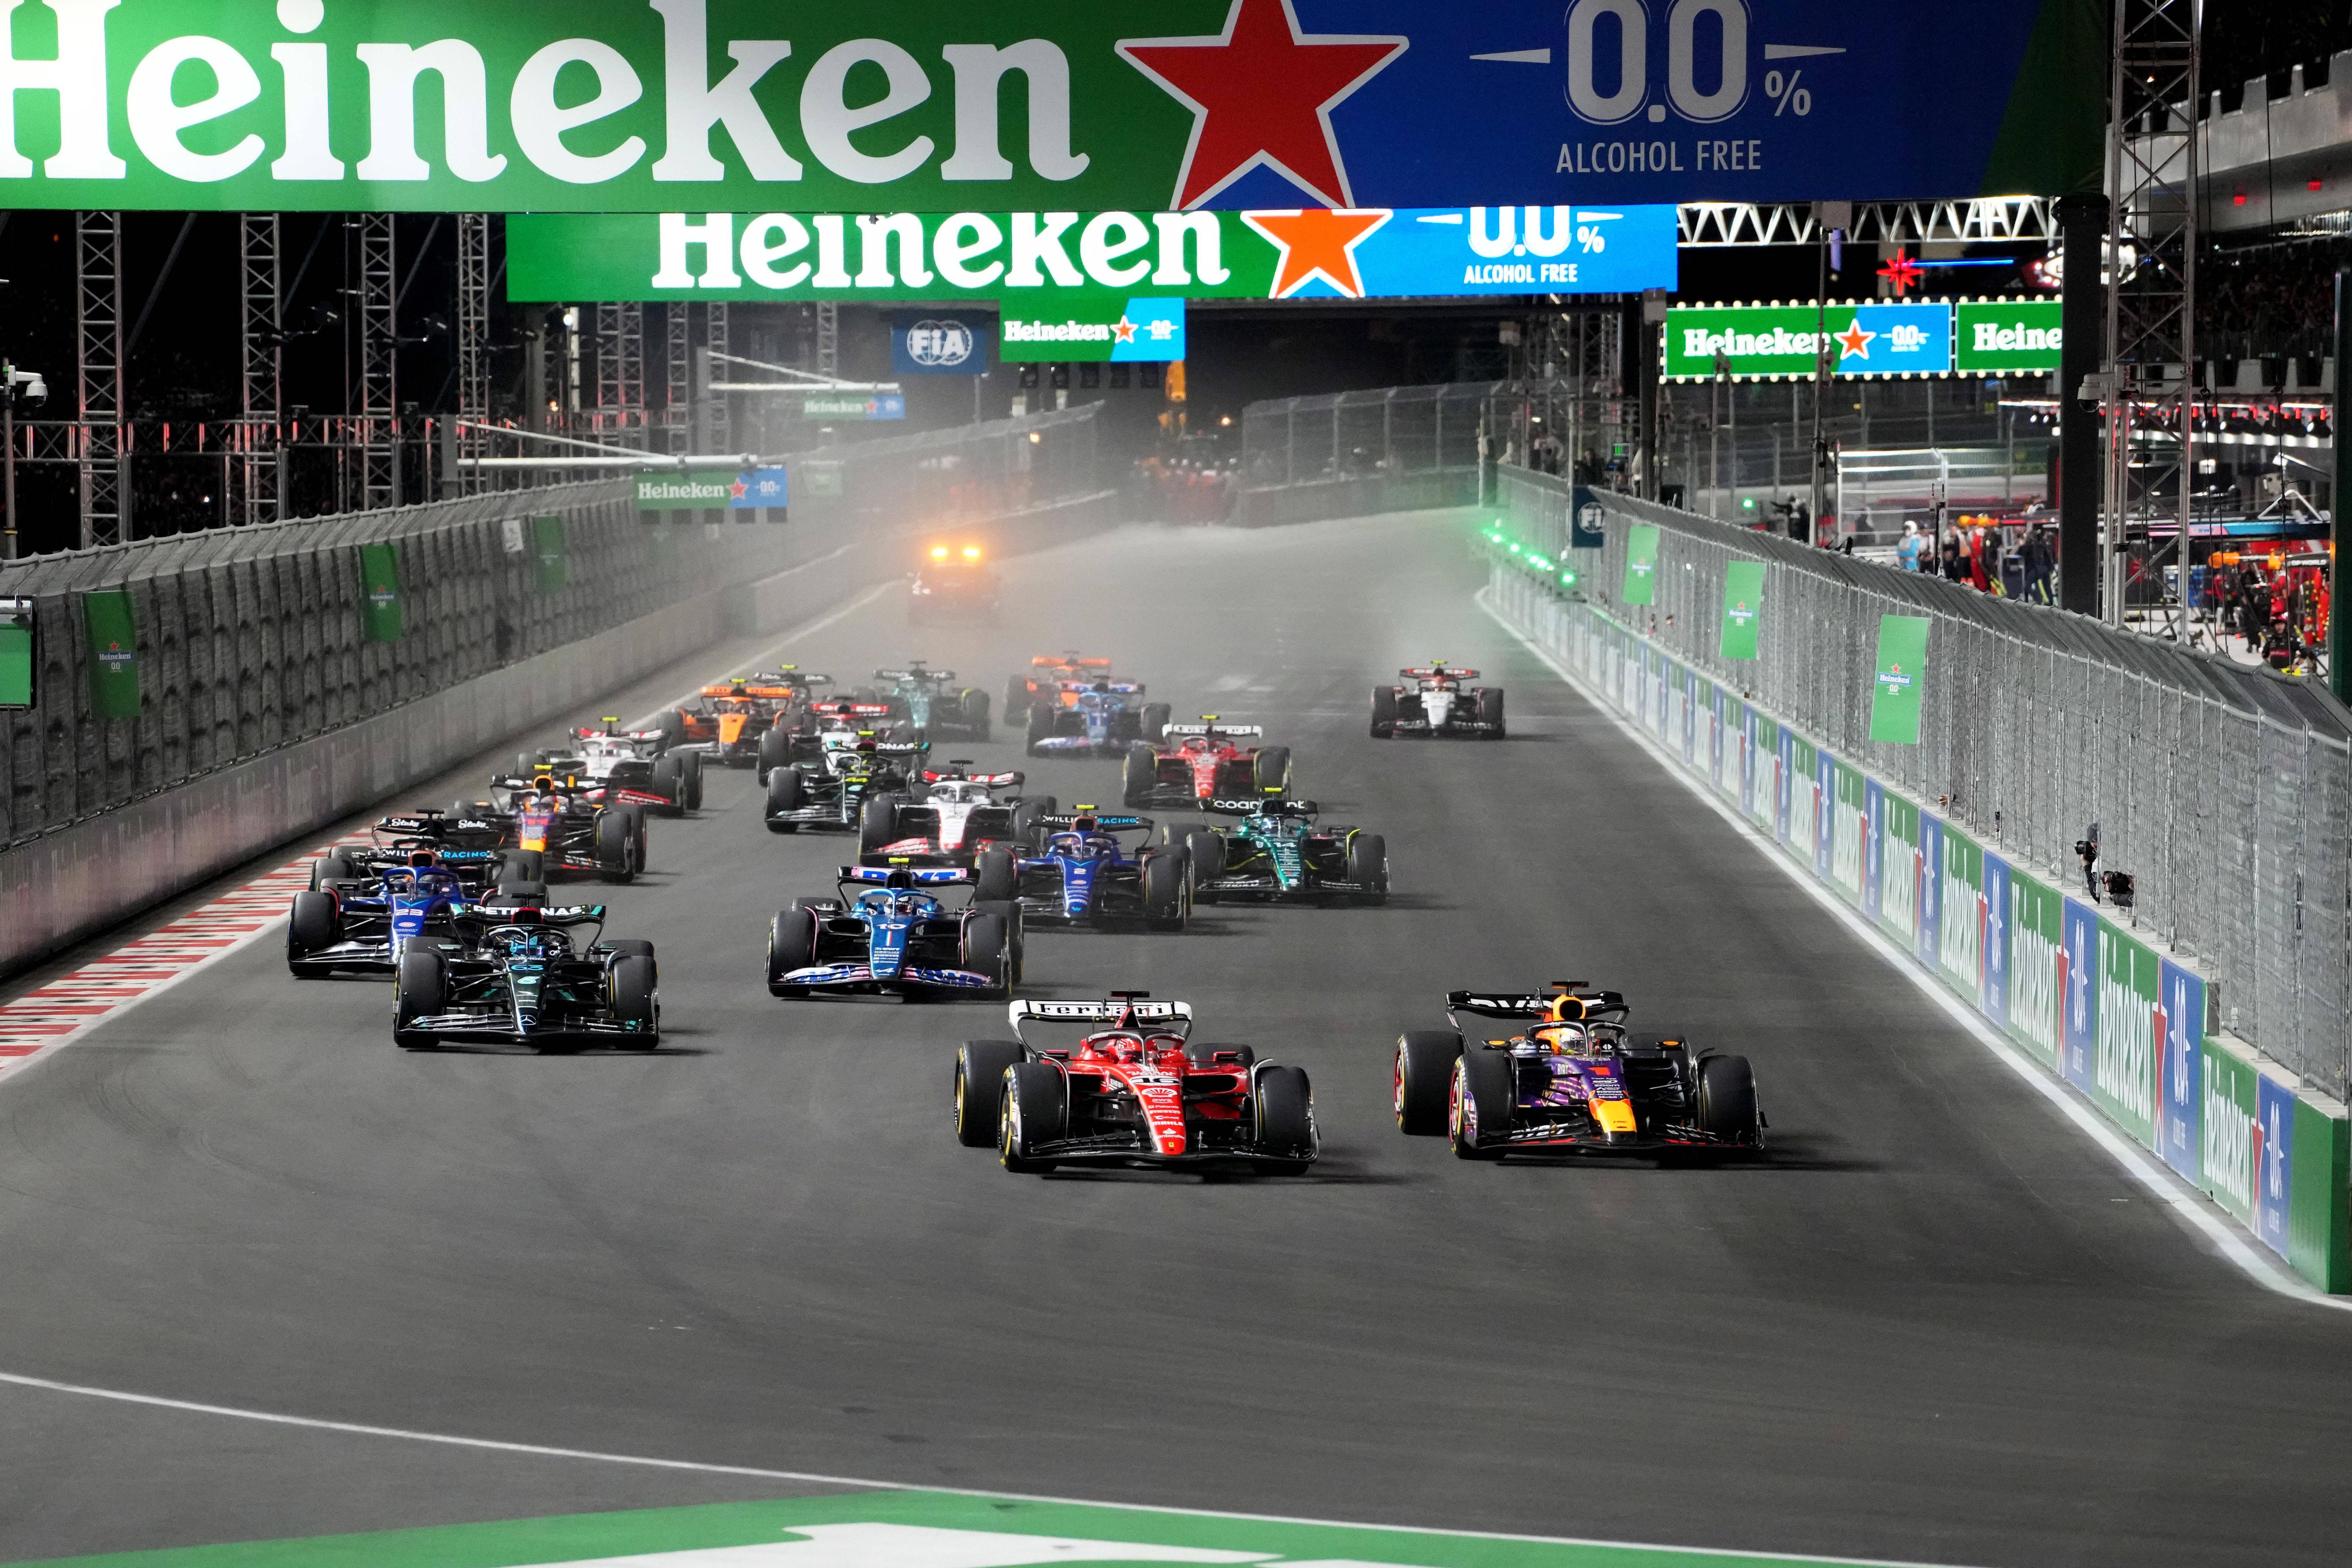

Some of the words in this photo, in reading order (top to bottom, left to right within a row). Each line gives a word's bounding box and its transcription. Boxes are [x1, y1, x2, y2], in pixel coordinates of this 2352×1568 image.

[0, 0, 1091, 183] Heineken
[1556, 141, 1685, 174] ALCOHOL
[1697, 138, 1763, 172] FREE
[652, 211, 1230, 288] Heineken
[1463, 264, 1538, 284] ALCOHOL
[1544, 263, 1579, 283] FREE
[1004, 321, 1110, 342] Heineken
[1683, 327, 1831, 356] Heineken
[1973, 322, 2062, 350] Heine
[638, 482, 724, 499] Heineken
[99, 653, 131, 661] Heineken
[1879, 674, 1910, 684] Heineken
[1941, 835, 1976, 990] Heineken
[2010, 882, 2055, 1054] Heineken
[2097, 930, 2151, 1124] Heineken
[2203, 1053, 2250, 1209] Heineken
